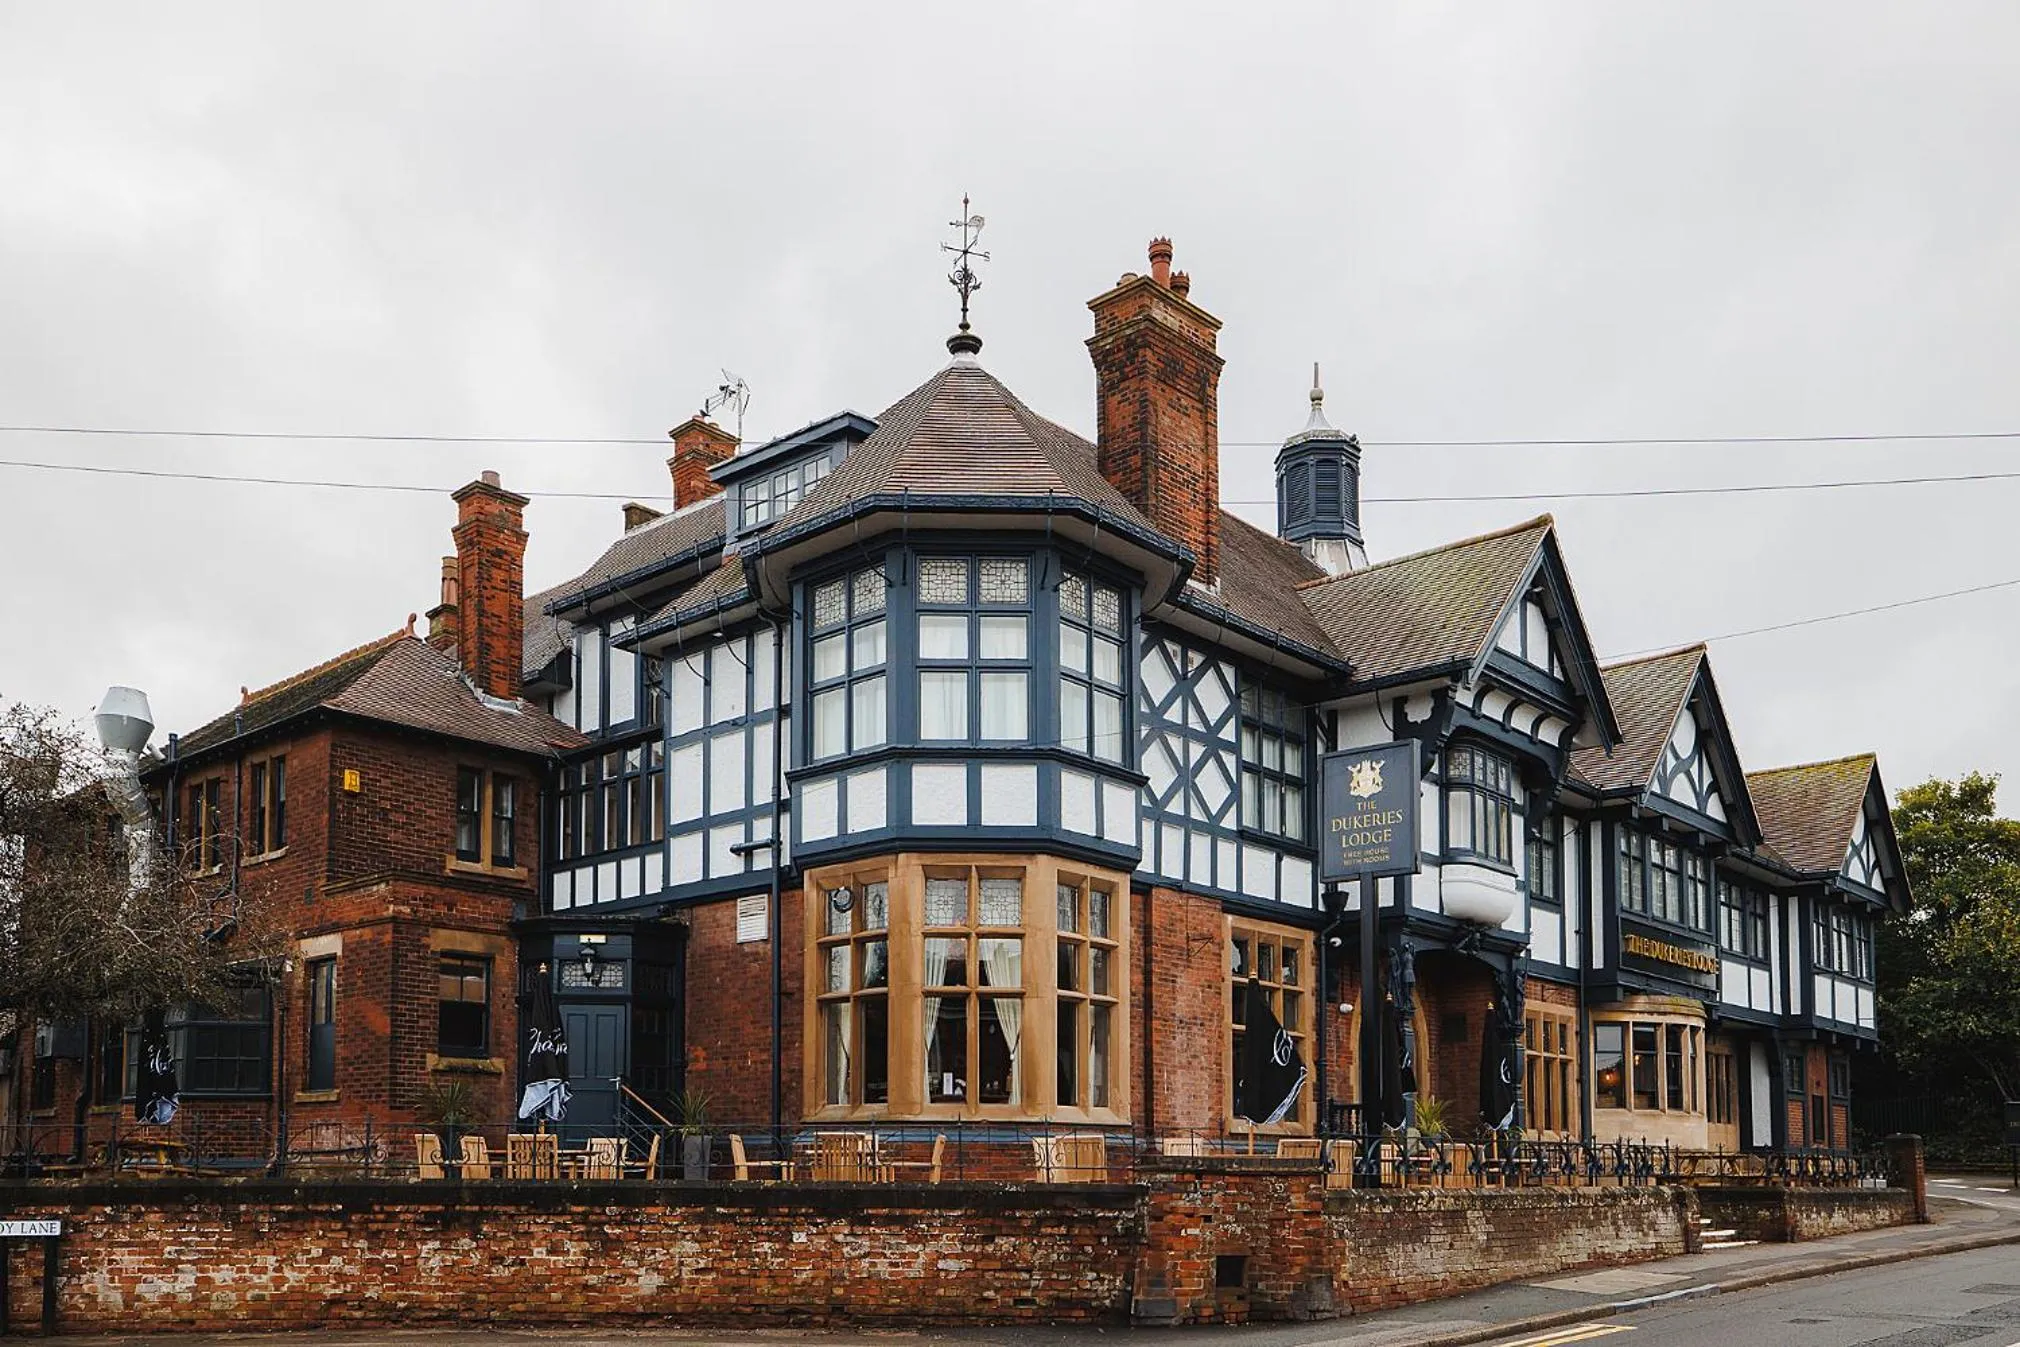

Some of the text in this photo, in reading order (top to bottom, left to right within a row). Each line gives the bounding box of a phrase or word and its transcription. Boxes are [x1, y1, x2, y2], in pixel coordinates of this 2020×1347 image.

[1356, 799, 1376, 811] THE
[1331, 809, 1403, 832] DUKERIES
[1342, 829, 1392, 848] LODGE
[1624, 934, 1650, 956] THE
[21, 1222, 57, 1234] LANE
